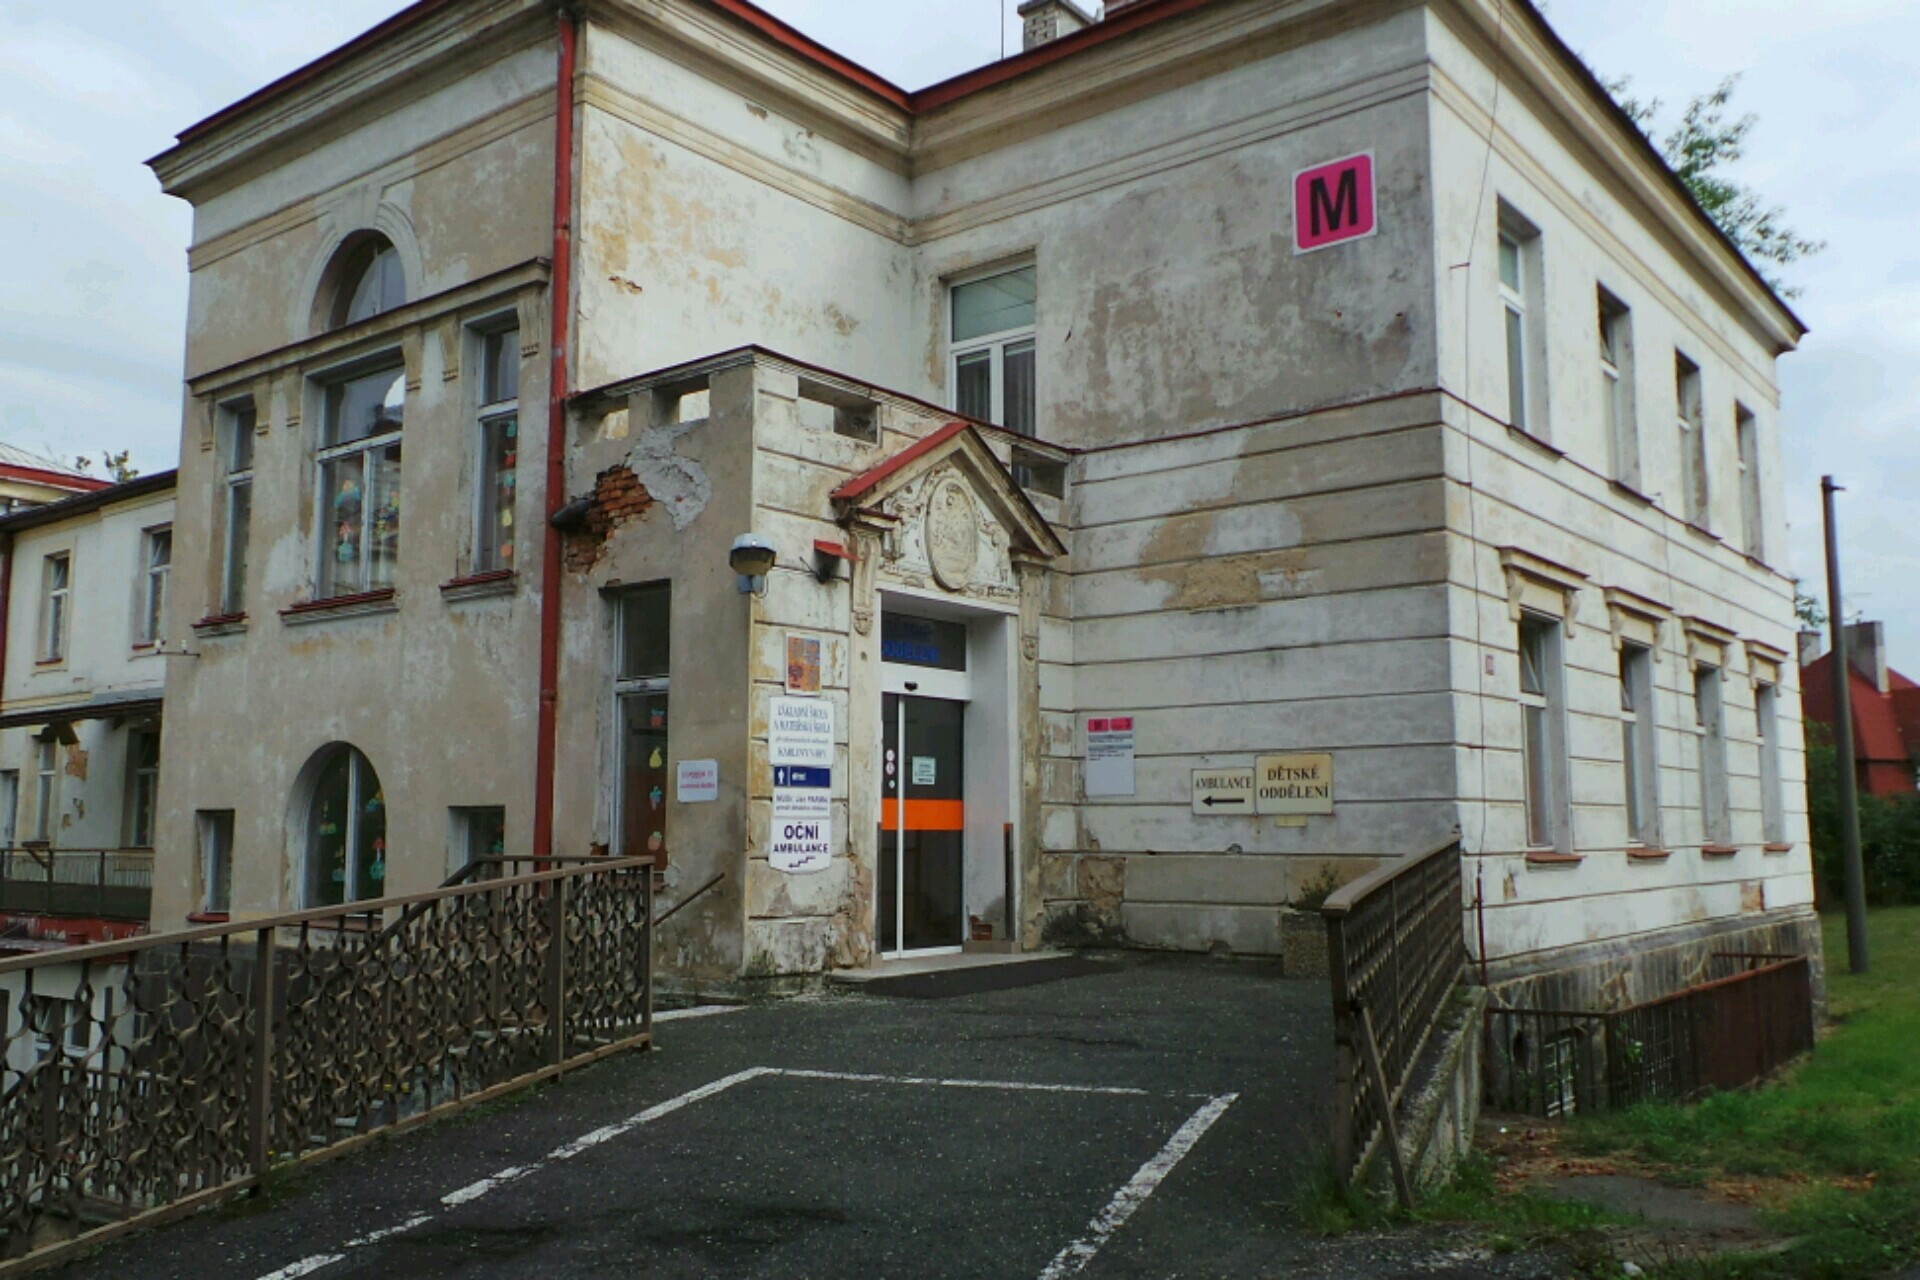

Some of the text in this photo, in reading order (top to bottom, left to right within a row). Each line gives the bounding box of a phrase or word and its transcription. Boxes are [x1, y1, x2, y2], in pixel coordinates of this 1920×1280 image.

[1309, 167, 1358, 237] M
[1267, 763, 1320, 781] DĚTSKÉ
[1195, 775, 1252, 790] AMBULANCE
[1260, 782, 1328, 799] ODDĚLENÍ
[784, 821, 818, 840] OČNÍ
[773, 843, 828, 854] AMBULANCE
